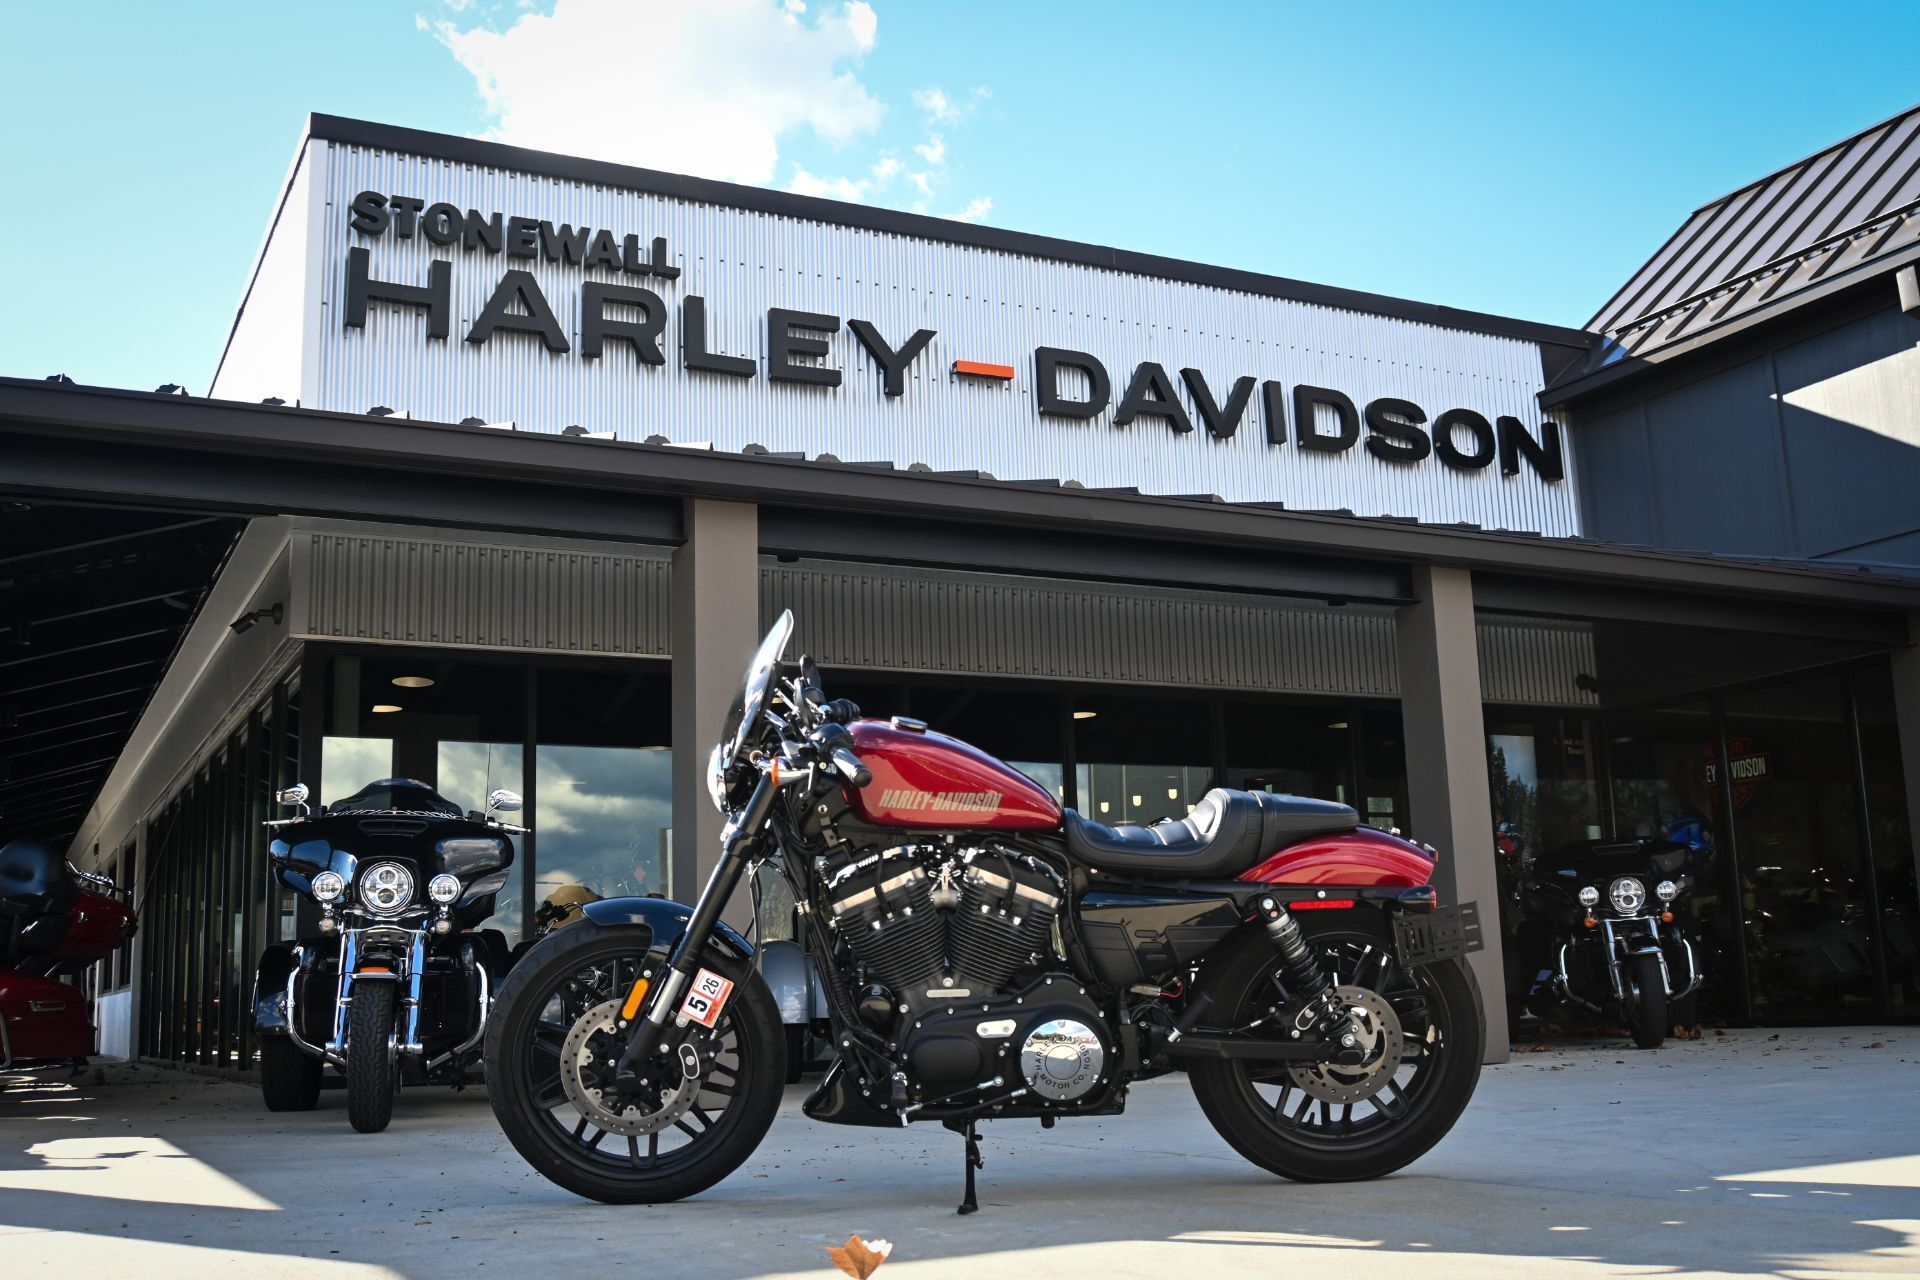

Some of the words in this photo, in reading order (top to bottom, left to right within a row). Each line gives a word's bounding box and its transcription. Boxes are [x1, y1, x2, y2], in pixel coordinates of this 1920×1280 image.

[349, 190, 681, 280] STONEWALL
[879, 789, 1002, 812] HARLEY-DAVIDSON
[688, 997, 708, 1012] 5
[702, 978, 719, 994] 26
[1040, 1073, 1070, 1089] MOTOR
